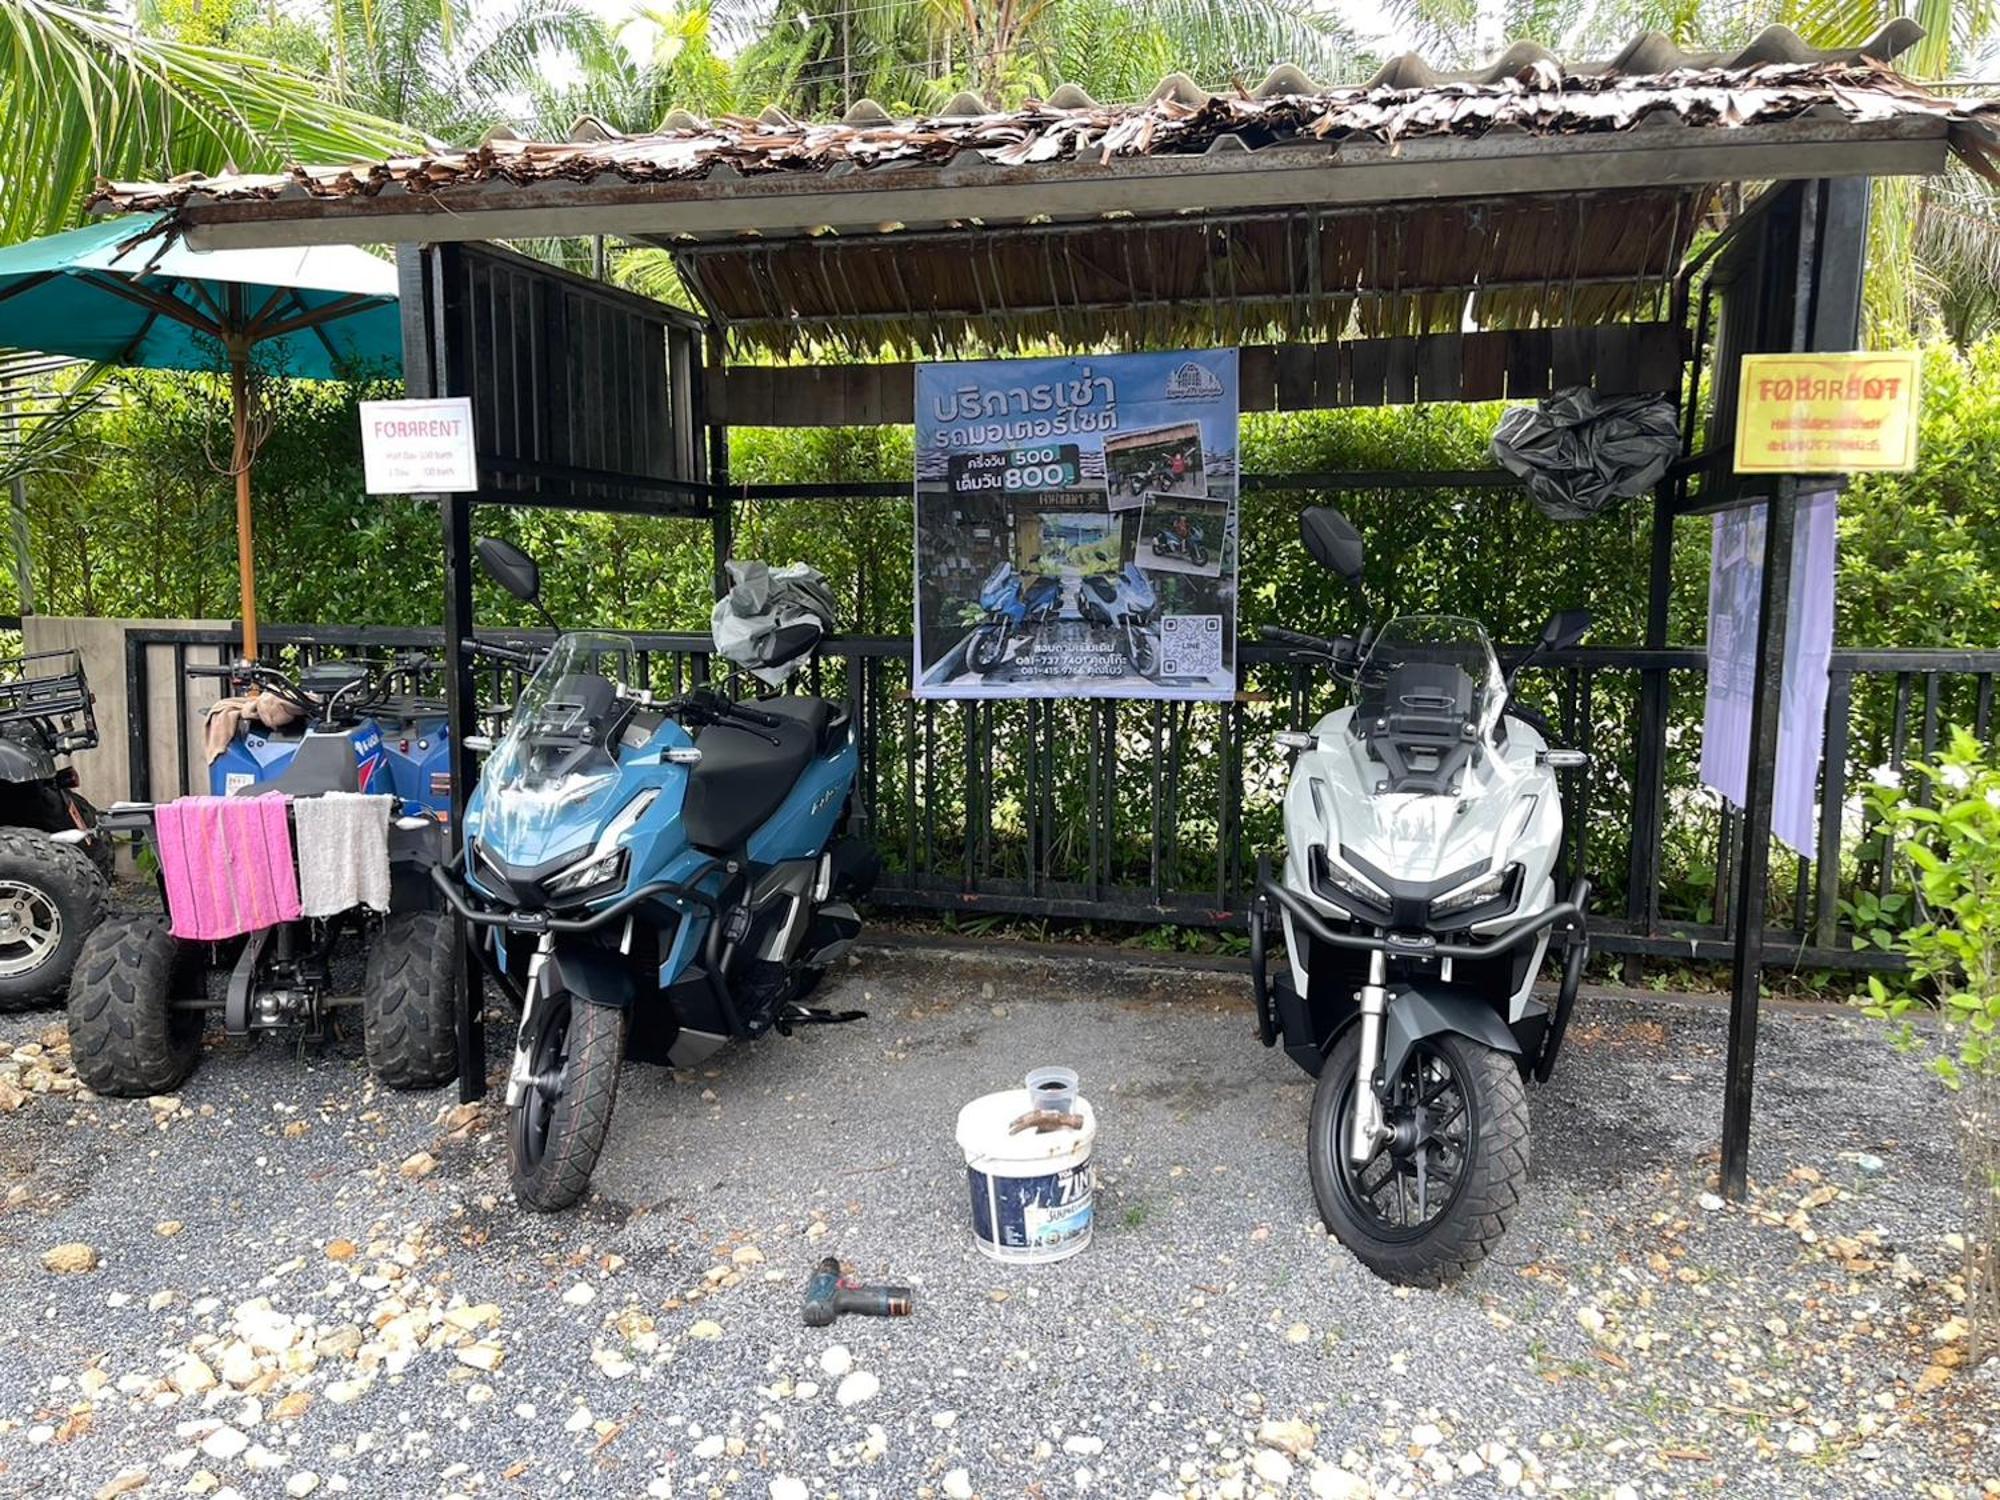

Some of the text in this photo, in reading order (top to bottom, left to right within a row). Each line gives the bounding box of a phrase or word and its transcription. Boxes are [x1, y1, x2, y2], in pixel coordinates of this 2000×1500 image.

[932, 367, 1117, 422] บริการเช่า
[955, 471, 1002, 492] เต็มวัน
[1182, 642, 1201, 650] LINE
